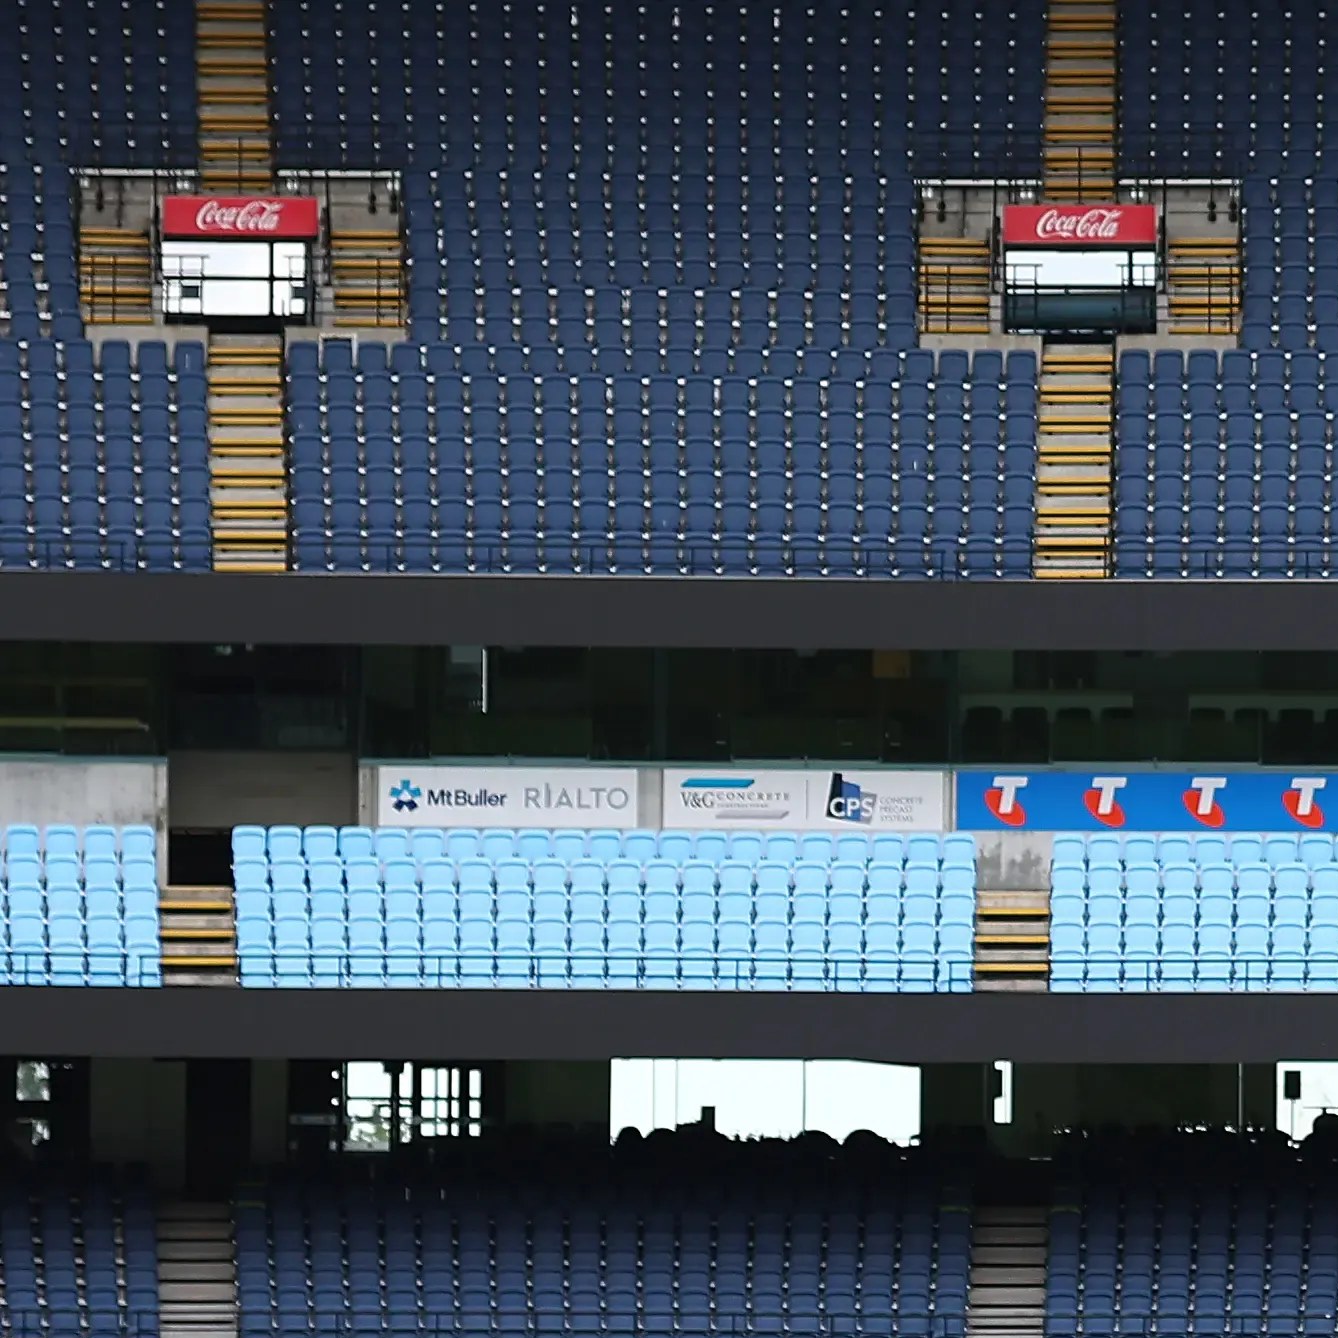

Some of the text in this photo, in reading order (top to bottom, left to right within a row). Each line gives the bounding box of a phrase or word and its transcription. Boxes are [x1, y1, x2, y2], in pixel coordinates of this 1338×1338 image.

[524, 783, 629, 810] RIALTO
[680, 791, 790, 809] V&G CONCRETE
[829, 796, 873, 817] CPS
